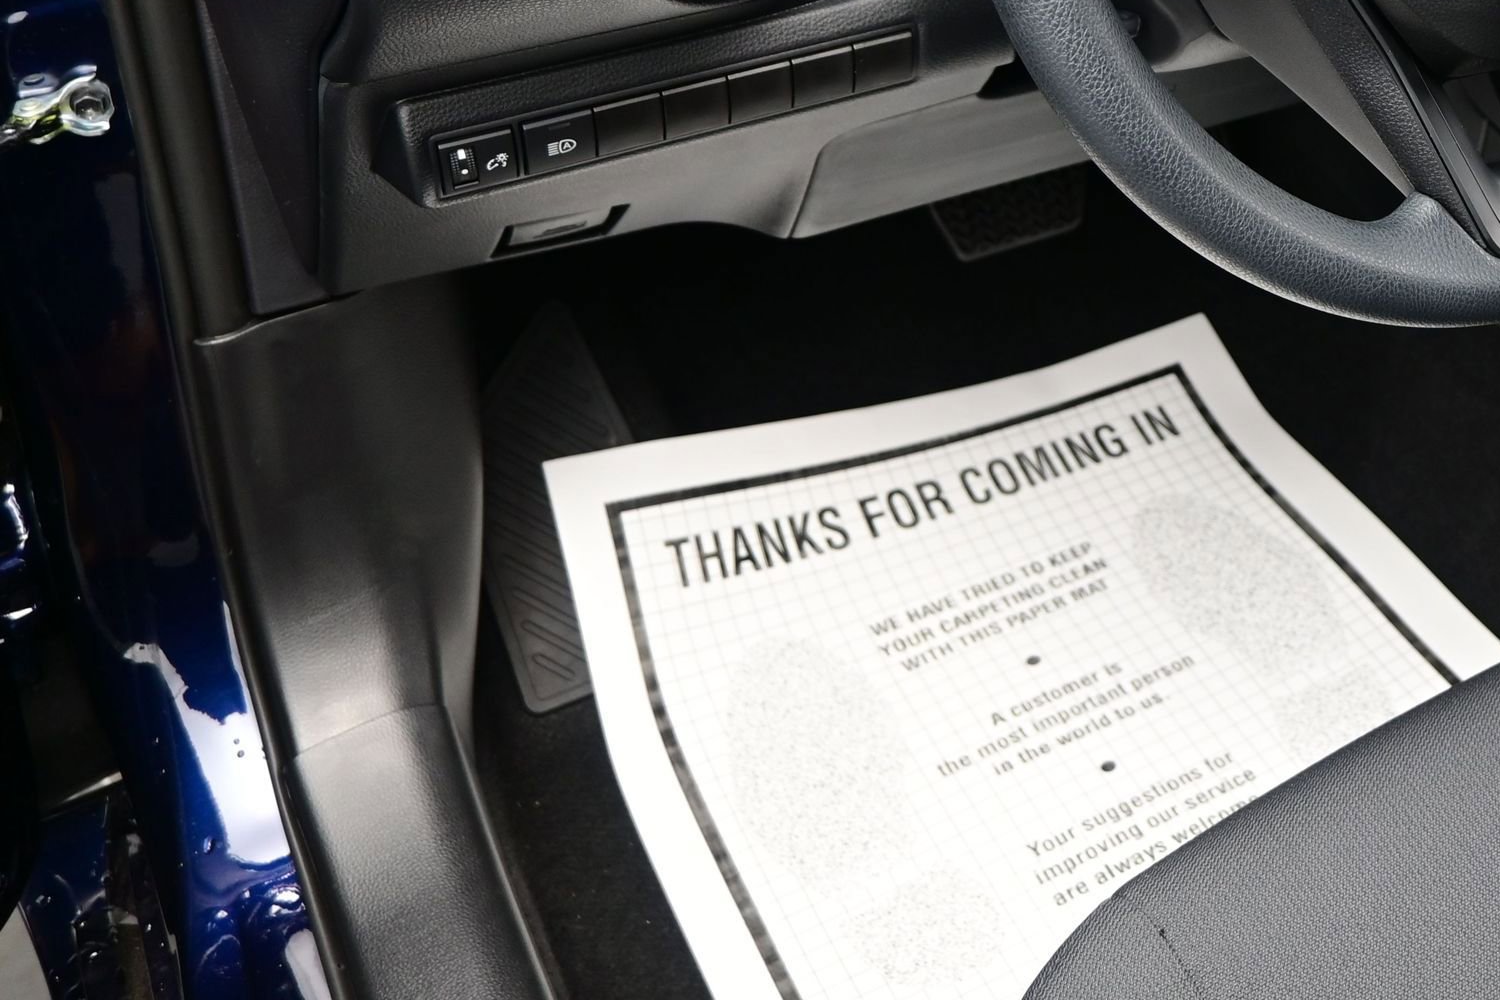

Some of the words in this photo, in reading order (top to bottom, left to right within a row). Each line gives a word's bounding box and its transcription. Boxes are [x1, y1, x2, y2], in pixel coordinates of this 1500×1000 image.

[664, 506, 851, 588] THANKS
[859, 480, 954, 539] FOR
[960, 424, 1129, 504] COMING
[1131, 405, 1180, 445] IN
[870, 616, 899, 637] WE
[906, 594, 957, 623] HAVE
[961, 572, 1016, 601] TRIED
[1020, 561, 1045, 578] TO
[1048, 541, 1092, 567] KEEP
[878, 627, 935, 657] YOUR
[938, 582, 1045, 634] CARPETING
[1048, 558, 1108, 589] CLEAN
[901, 643, 954, 672] WITH
[959, 620, 1002, 647] THIS
[1006, 597, 1067, 628] PAPER
[1071, 578, 1109, 602] MAT
[936, 754, 972, 777] the
[977, 726, 1029, 759] most
[1031, 683, 1128, 733] important
[1130, 653, 1196, 692] person
[990, 711, 1006, 726] A
[1010, 671, 1100, 718] customer
[1103, 661, 1123, 677] is
[992, 759, 1014, 777] in
[1017, 741, 1051, 765] the
[1056, 714, 1112, 747] world
[1114, 704, 1136, 721] to
[1026, 826, 1077, 858] Your
[1081, 765, 1204, 832] suggestions
[1204, 750, 1234, 773] for
[1034, 824, 1144, 886] improving
[1146, 805, 1180, 829] our
[1184, 767, 1257, 811] service
[1053, 881, 1090, 907] are
[1094, 839, 1168, 885] always
